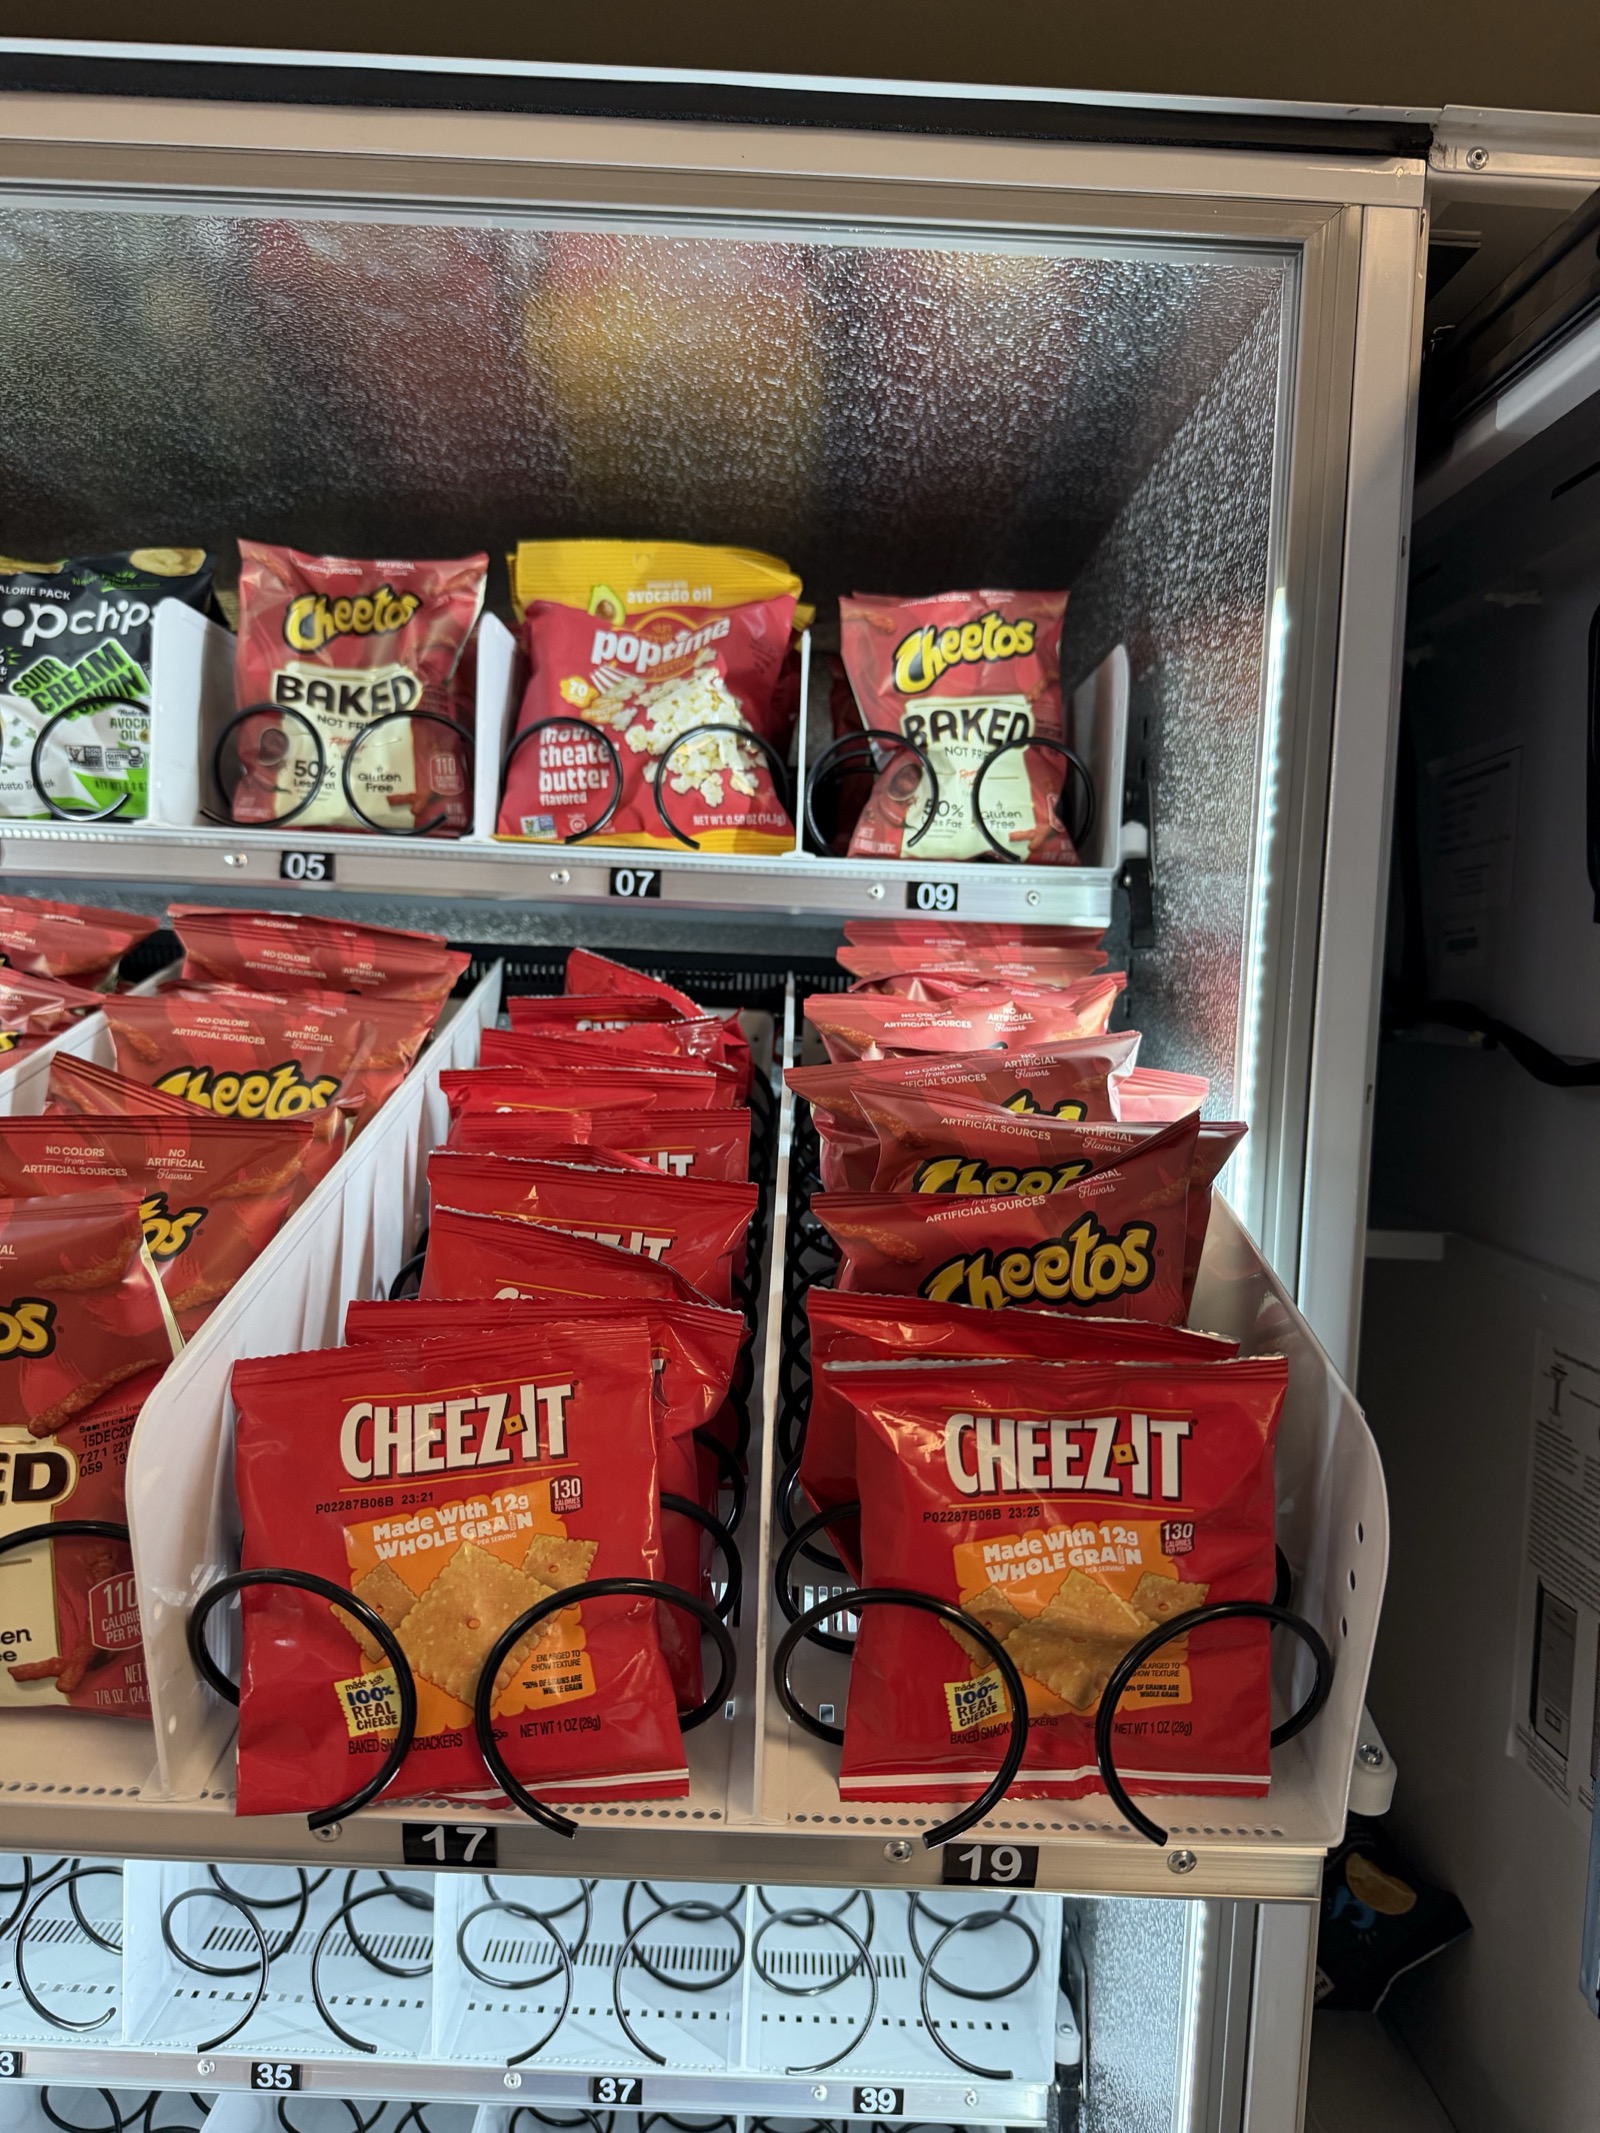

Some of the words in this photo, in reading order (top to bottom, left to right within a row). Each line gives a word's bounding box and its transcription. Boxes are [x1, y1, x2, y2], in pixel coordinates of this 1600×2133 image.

[39, 588, 71, 601] PACK
[626, 586, 689, 604] avocado
[692, 586, 712, 602] oil
[284, 584, 421, 652] Cheetos
[591, 616, 731, 673] poptime
[891, 610, 1037, 694] Cheetos
[12, 658, 66, 697] SOUR
[31, 641, 128, 715] CREAM
[276, 674, 417, 717] BAKED
[569, 680, 588, 697] 70
[317, 715, 343, 728] NOT
[903, 707, 1030, 748] BAKED
[120, 730, 138, 741] OIL
[539, 741, 620, 768] theate
[944, 746, 969, 758] NOT
[435, 757, 457, 775] 110
[358, 773, 402, 783] Gluten
[539, 768, 610, 793] butter
[366, 783, 394, 793] Free
[540, 792, 587, 806] flavored
[693, 814, 709, 826] NET
[710, 815, 725, 826] WT.
[980, 809, 1022, 819] Gluten
[946, 818, 963, 829] Fat
[990, 819, 1016, 829] Free
[286, 852, 326, 880] 05
[615, 870, 655, 897] 07
[916, 883, 955, 911] 09
[277, 951, 311, 963] COLORS
[244, 961, 289, 974] ARTIFICIAL
[289, 967, 327, 979] SOURCES
[342, 967, 386, 979] ARTIFICIAL
[358, 962, 372, 970] NO
[987, 1013, 1034, 1022] ARTIFICIAL
[1003, 1007, 1017, 1015] NO
[197, 1016, 211, 1025] NO
[212, 1017, 250, 1028] COLORS
[304, 1025, 319, 1033] NO
[884, 1021, 930, 1029] ARTIFICIAL
[931, 1020, 972, 1029] SOURCES
[994, 1022, 1026, 1032] Flavors
[172, 1027, 222, 1041] ARTIFICIAL
[222, 1033, 265, 1045] SOURCES
[284, 1030, 334, 1043] ARTIFICIAL
[291, 1040, 325, 1052] Flavors
[904, 1068, 920, 1076] NO
[922, 1062, 963, 1074] COLORS
[1004, 1056, 1058, 1069] ARTIFICIAL
[941, 1073, 987, 1085] SOURCES
[1014, 1068, 1050, 1080] Flavors
[941, 1117, 998, 1133] ARTIFICIAL
[1000, 1123, 1051, 1141] SOURCES
[1074, 1126, 1134, 1143] ARTIFICIAL
[45, 1145, 61, 1155] NO
[62, 1146, 105, 1157] COLORS
[168, 1148, 186, 1158] NO
[1082, 1137, 1122, 1154] Flavors
[64, 1156, 86, 1166] from
[147, 1157, 205, 1169] ARTIFICIAL
[22, 1164, 79, 1175] ARTIFICIAL
[79, 1166, 128, 1177] SOURCES
[157, 1168, 193, 1181] Flavors
[1079, 1183, 1116, 1199] Flavors
[926, 1205, 988, 1224] ARTIFICIAL
[990, 1194, 1046, 1213] SOURCES
[80, 1461, 103, 1477] 059
[552, 1478, 581, 1499] 130
[315, 1496, 394, 1515] P02287B06B
[401, 1491, 434, 1505] 23:21
[373, 1515, 435, 1542] Made
[436, 1501, 489, 1527] With
[491, 1493, 529, 1513] 12g
[922, 1507, 1001, 1523] P02287B06B
[1008, 1505, 1040, 1519] 23:25
[375, 1526, 458, 1560] WHOLE
[460, 1511, 533, 1540] GRAIN
[477, 1537, 490, 1546] PER
[491, 1532, 517, 1544] SERVING
[1163, 1523, 1194, 1540] 130
[982, 1538, 1042, 1564] Made
[1043, 1527, 1095, 1552] With
[1099, 1525, 1138, 1546] 12g
[985, 1553, 1067, 1584] WHOLE
[1068, 1544, 1143, 1567] GRAIN
[1098, 1564, 1125, 1574] SERVING
[103, 1578, 140, 1615] 110
[101, 1610, 142, 1632] CALORIE
[106, 1629, 125, 1644] PER
[536, 1650, 571, 1662] ENLARGED
[571, 1649, 581, 1658] TO
[531, 1661, 552, 1672] SHOW
[553, 1658, 581, 1669] TEXTURE
[1151, 1669, 1180, 1677] TEXTURE
[1171, 1662, 1180, 1670] TO
[125, 1664, 142, 1684] NET
[571, 1674, 583, 1683] ARE
[344, 1679, 368, 1692] made
[564, 1682, 583, 1692] GRAIN
[954, 1682, 976, 1692] made
[94, 1688, 112, 1706] 7/8
[346, 1685, 395, 1706] 100%
[954, 1682, 999, 1707] 100%
[351, 1701, 396, 1720] REAL
[957, 1695, 997, 1719] REAL
[356, 1714, 398, 1730] CHEESE
[959, 1704, 998, 1727] CHEESE
[520, 1722, 538, 1738] NET
[540, 1721, 554, 1735] WT
[557, 1719, 562, 1733] 1
[564, 1718, 578, 1732] OZ
[580, 1715, 601, 1733] (28g)
[950, 1729, 980, 1745] BAKED
[981, 1721, 1010, 1740] SNACK
[1114, 1723, 1132, 1735] NET
[1134, 1722, 1149, 1735] WT
[1150, 1721, 1155, 1735] 1
[1157, 1721, 1171, 1734] OZ
[1171, 1721, 1193, 1736] (28g)
[348, 1738, 379, 1755] BAKED
[412, 1732, 463, 1751] CRACKERS
[421, 1825, 488, 1863] 17
[957, 1845, 1023, 1883] 19
[256, 2063, 292, 2088] 35
[599, 2077, 636, 2103] 37
[860, 2088, 896, 2113] 39
